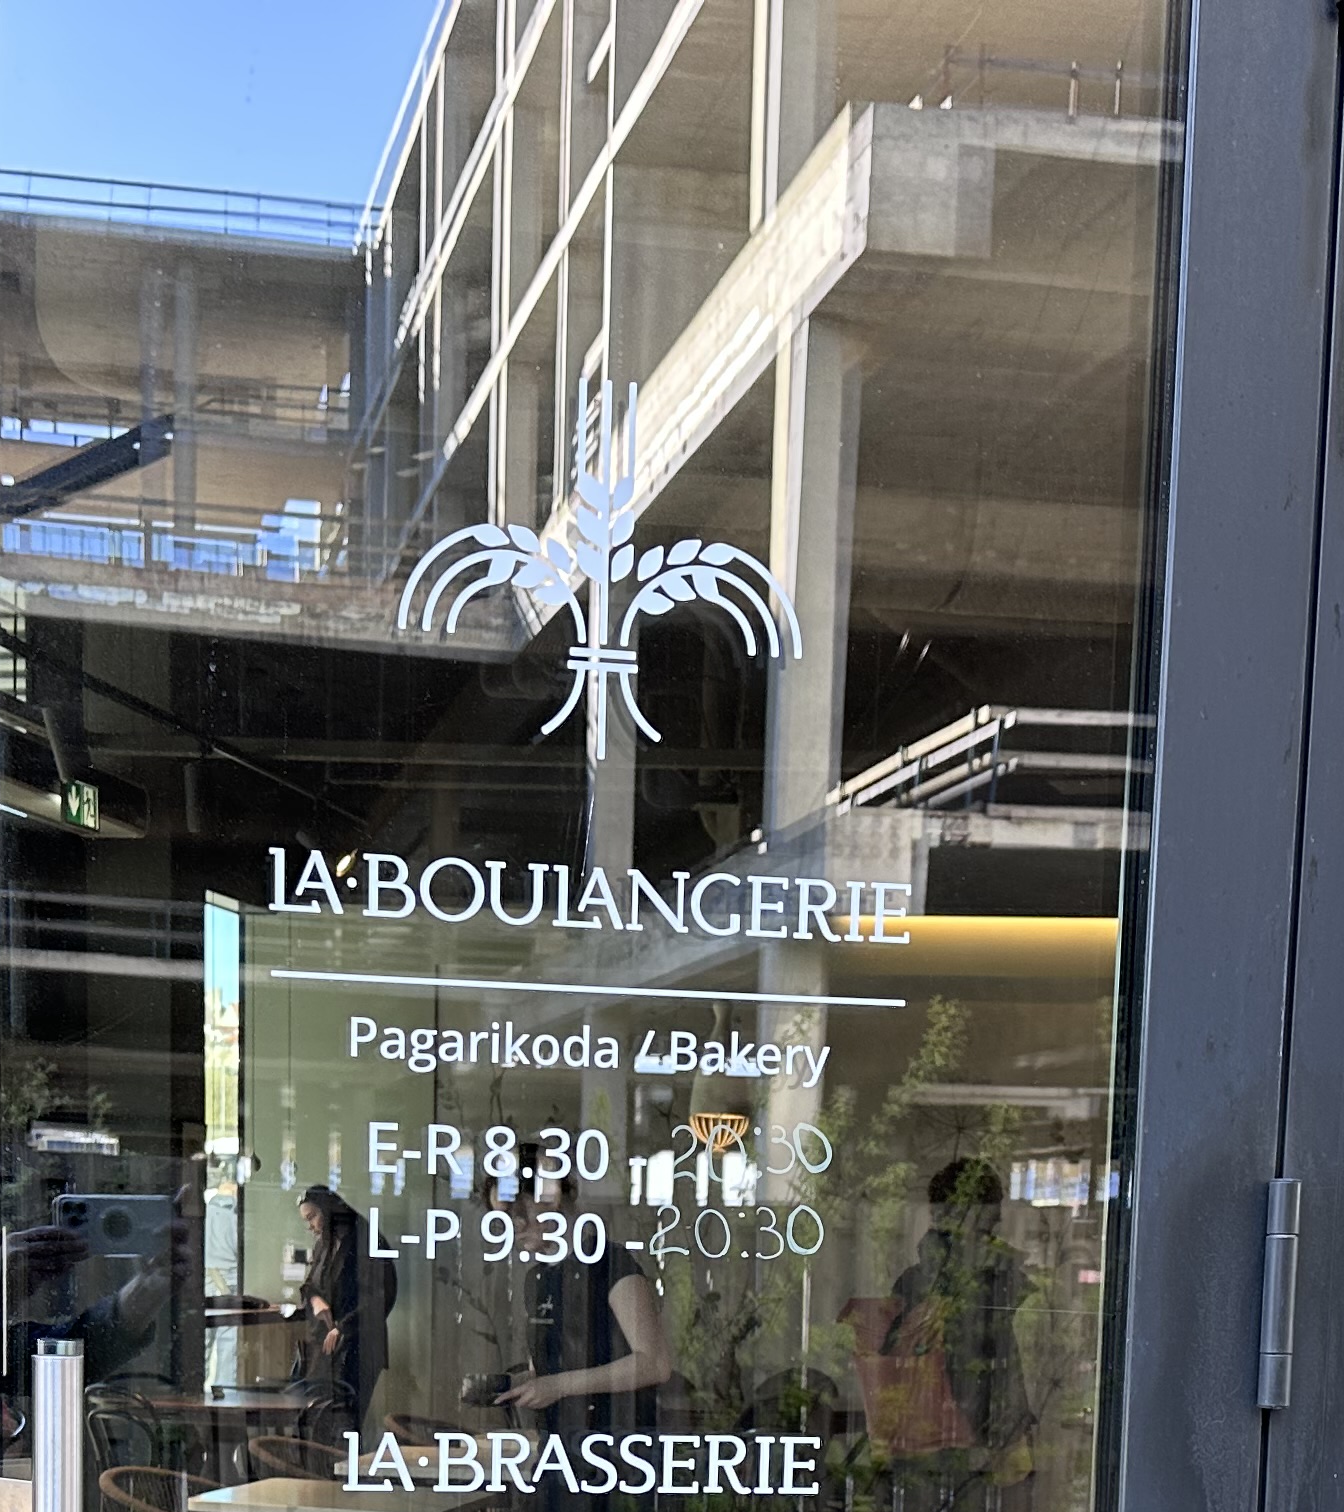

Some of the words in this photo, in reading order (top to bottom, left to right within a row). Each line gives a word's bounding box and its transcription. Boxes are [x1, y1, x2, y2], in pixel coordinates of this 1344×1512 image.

[350, 1017, 621, 1073] Pagarikoda
[639, 1029, 656, 1074] /
[669, 1031, 831, 1088] Bakery
[367, 1121, 461, 1177] E-R
[482, 1125, 610, 1182] 8.30
[368, 1208, 459, 1261] L-P
[480, 1210, 606, 1265] 9.30
[649, 1204, 825, 1260] 20:30
